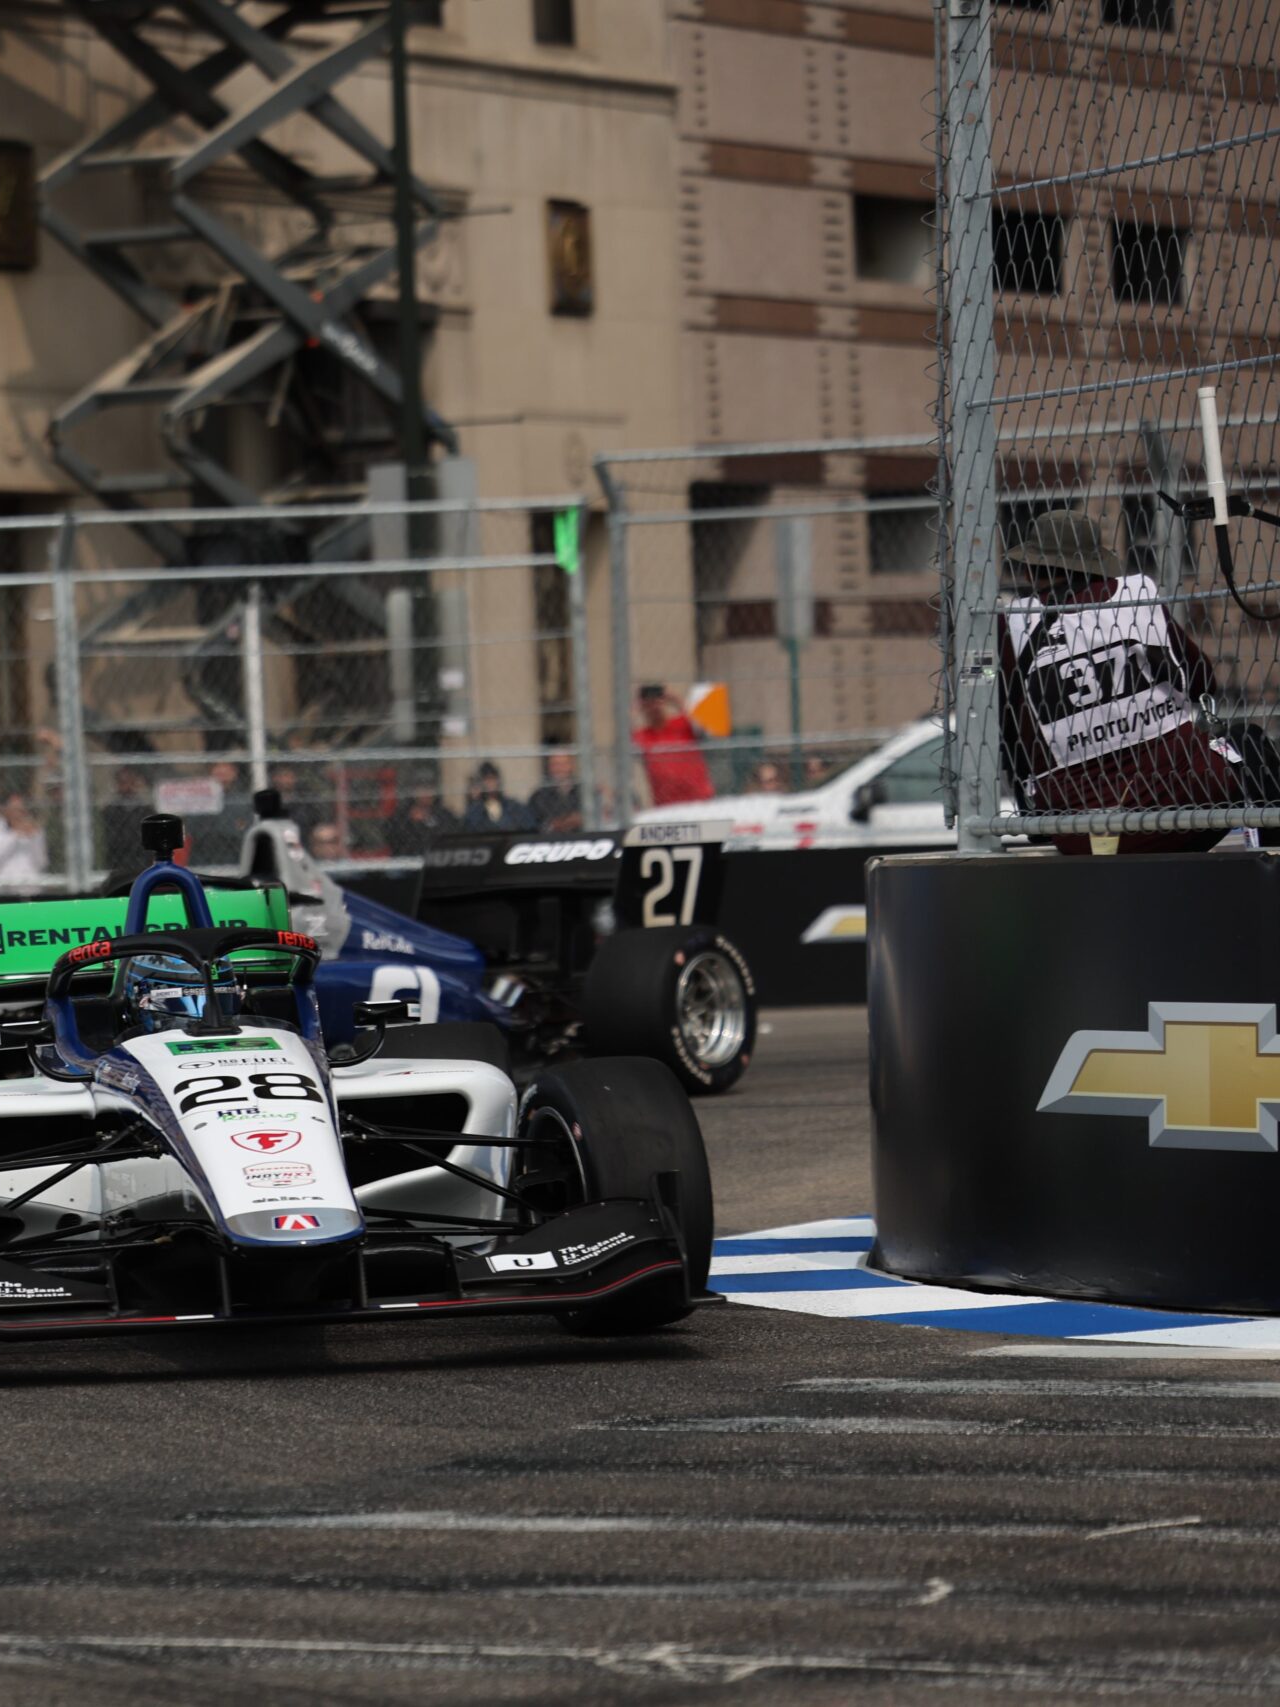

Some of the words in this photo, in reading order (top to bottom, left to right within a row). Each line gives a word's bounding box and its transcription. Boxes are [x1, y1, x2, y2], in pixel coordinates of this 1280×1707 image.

[638, 823, 701, 842] ANDRETTI
[503, 838, 615, 866] GRUPO
[639, 846, 704, 928] 27
[68, 939, 112, 962] renta
[277, 930, 316, 949] renta
[173, 1073, 324, 1115] 28
[16, 1287, 65, 1295] Ugland
